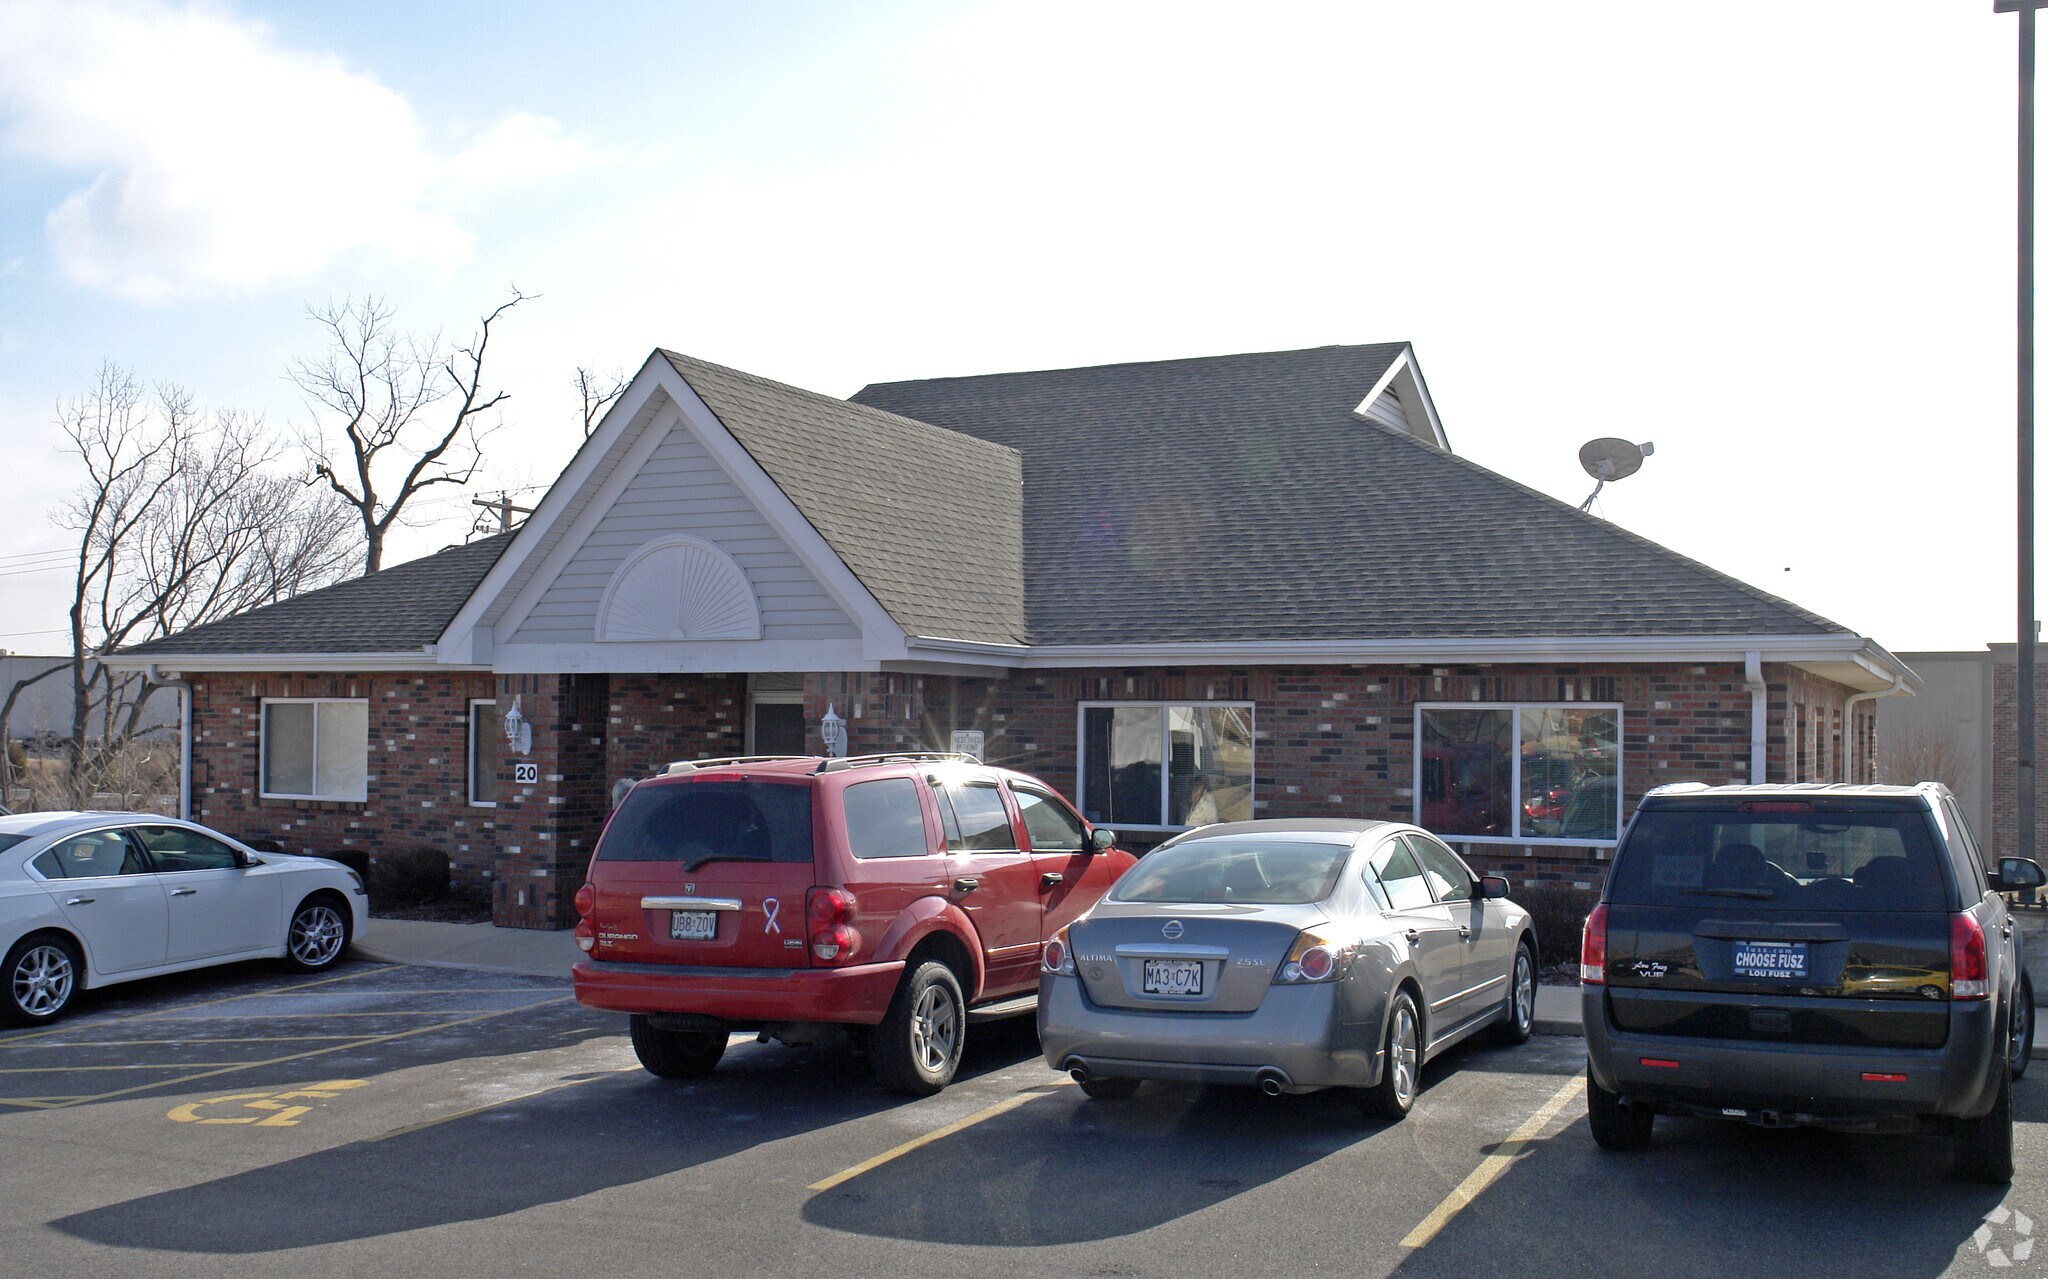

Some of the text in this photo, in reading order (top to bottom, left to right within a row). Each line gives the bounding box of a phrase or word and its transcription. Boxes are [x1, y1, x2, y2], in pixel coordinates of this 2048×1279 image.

[517, 766, 536, 780] 20
[673, 916, 692, 932] UB8
[598, 932, 639, 940] DURANGO
[1080, 954, 1113, 962] ALTIMA
[1736, 952, 1804, 969] CHOOSE FUSZ
[1146, 968, 1199, 987] MA3 C7K
[1768, 970, 1791, 978] FUSZ
